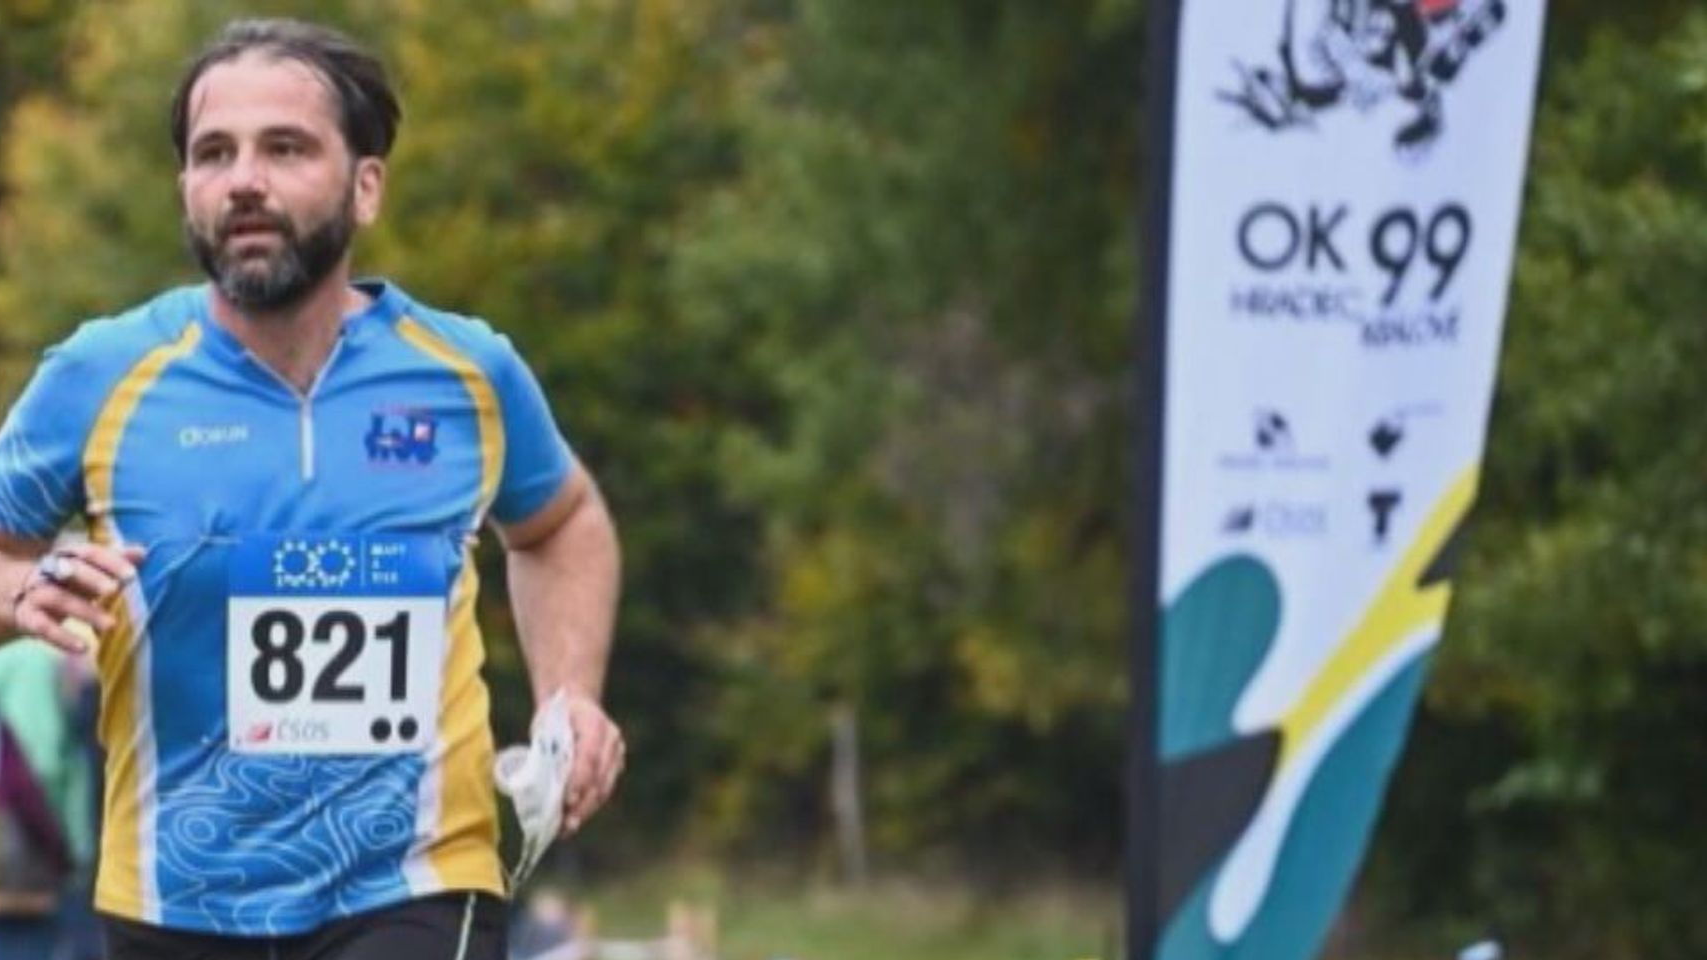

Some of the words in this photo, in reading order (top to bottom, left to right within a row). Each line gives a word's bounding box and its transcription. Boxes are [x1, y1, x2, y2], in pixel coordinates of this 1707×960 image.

[1237, 201, 1349, 272] OK
[1368, 201, 1473, 307] 99
[249, 609, 411, 705] 821
